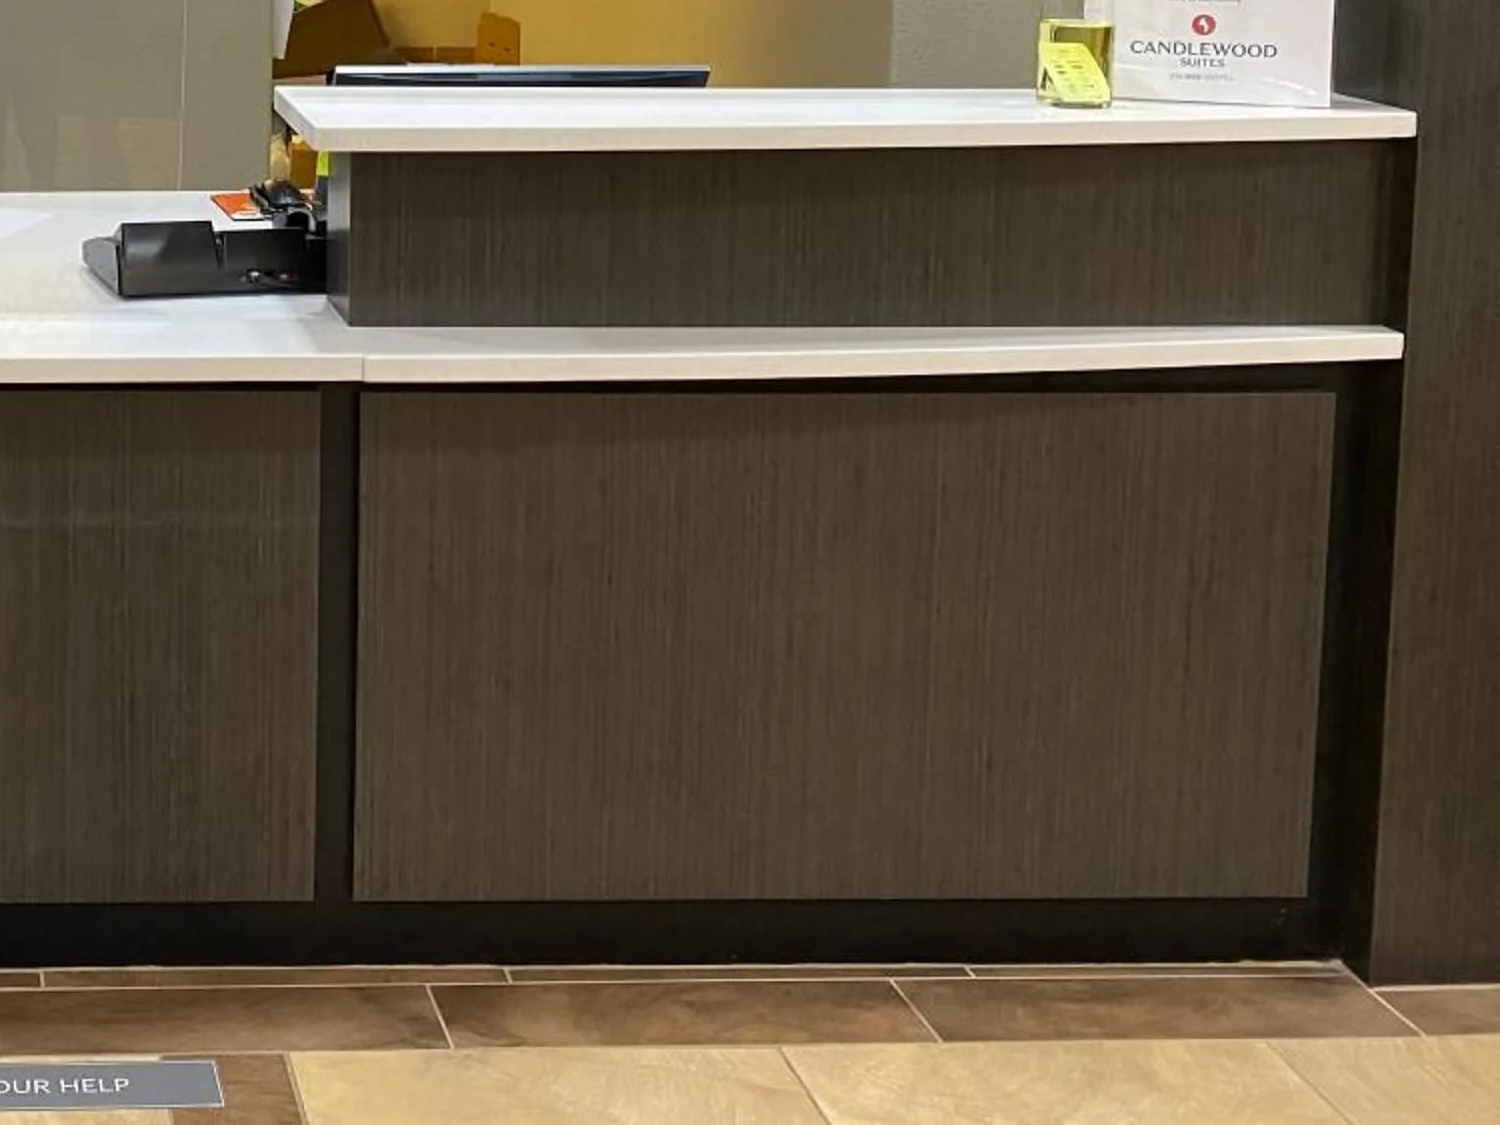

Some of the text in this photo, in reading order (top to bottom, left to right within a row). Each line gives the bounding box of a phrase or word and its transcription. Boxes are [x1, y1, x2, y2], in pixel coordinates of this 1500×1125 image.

[1129, 39, 1279, 59] CANDLEWOOD
[1179, 57, 1226, 68] SUITES
[59, 1077, 130, 1094] HELP
